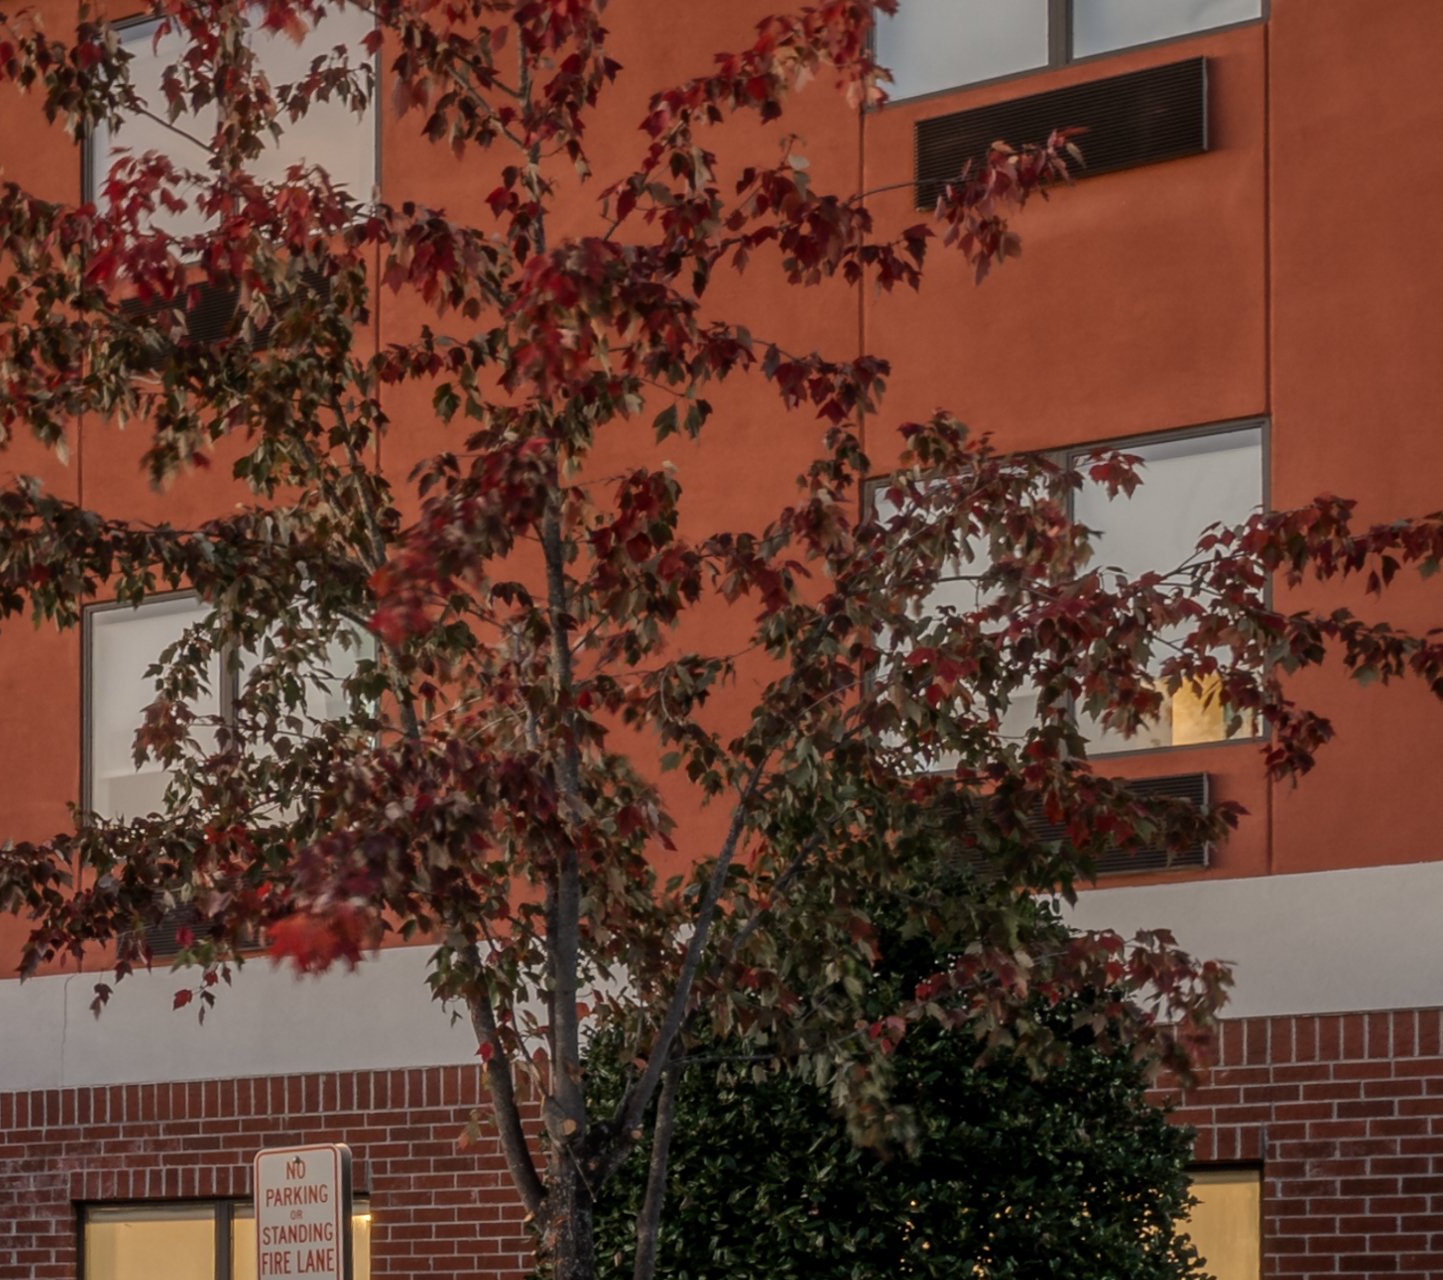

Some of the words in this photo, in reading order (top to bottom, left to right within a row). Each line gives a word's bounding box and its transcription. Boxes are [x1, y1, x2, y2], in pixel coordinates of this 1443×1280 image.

[286, 1160, 306, 1180] NO
[266, 1184, 328, 1207] PARKING
[290, 1209, 303, 1220] OR
[262, 1222, 333, 1245] STANDING
[262, 1250, 291, 1275] FIRE
[297, 1248, 334, 1274] LANE
